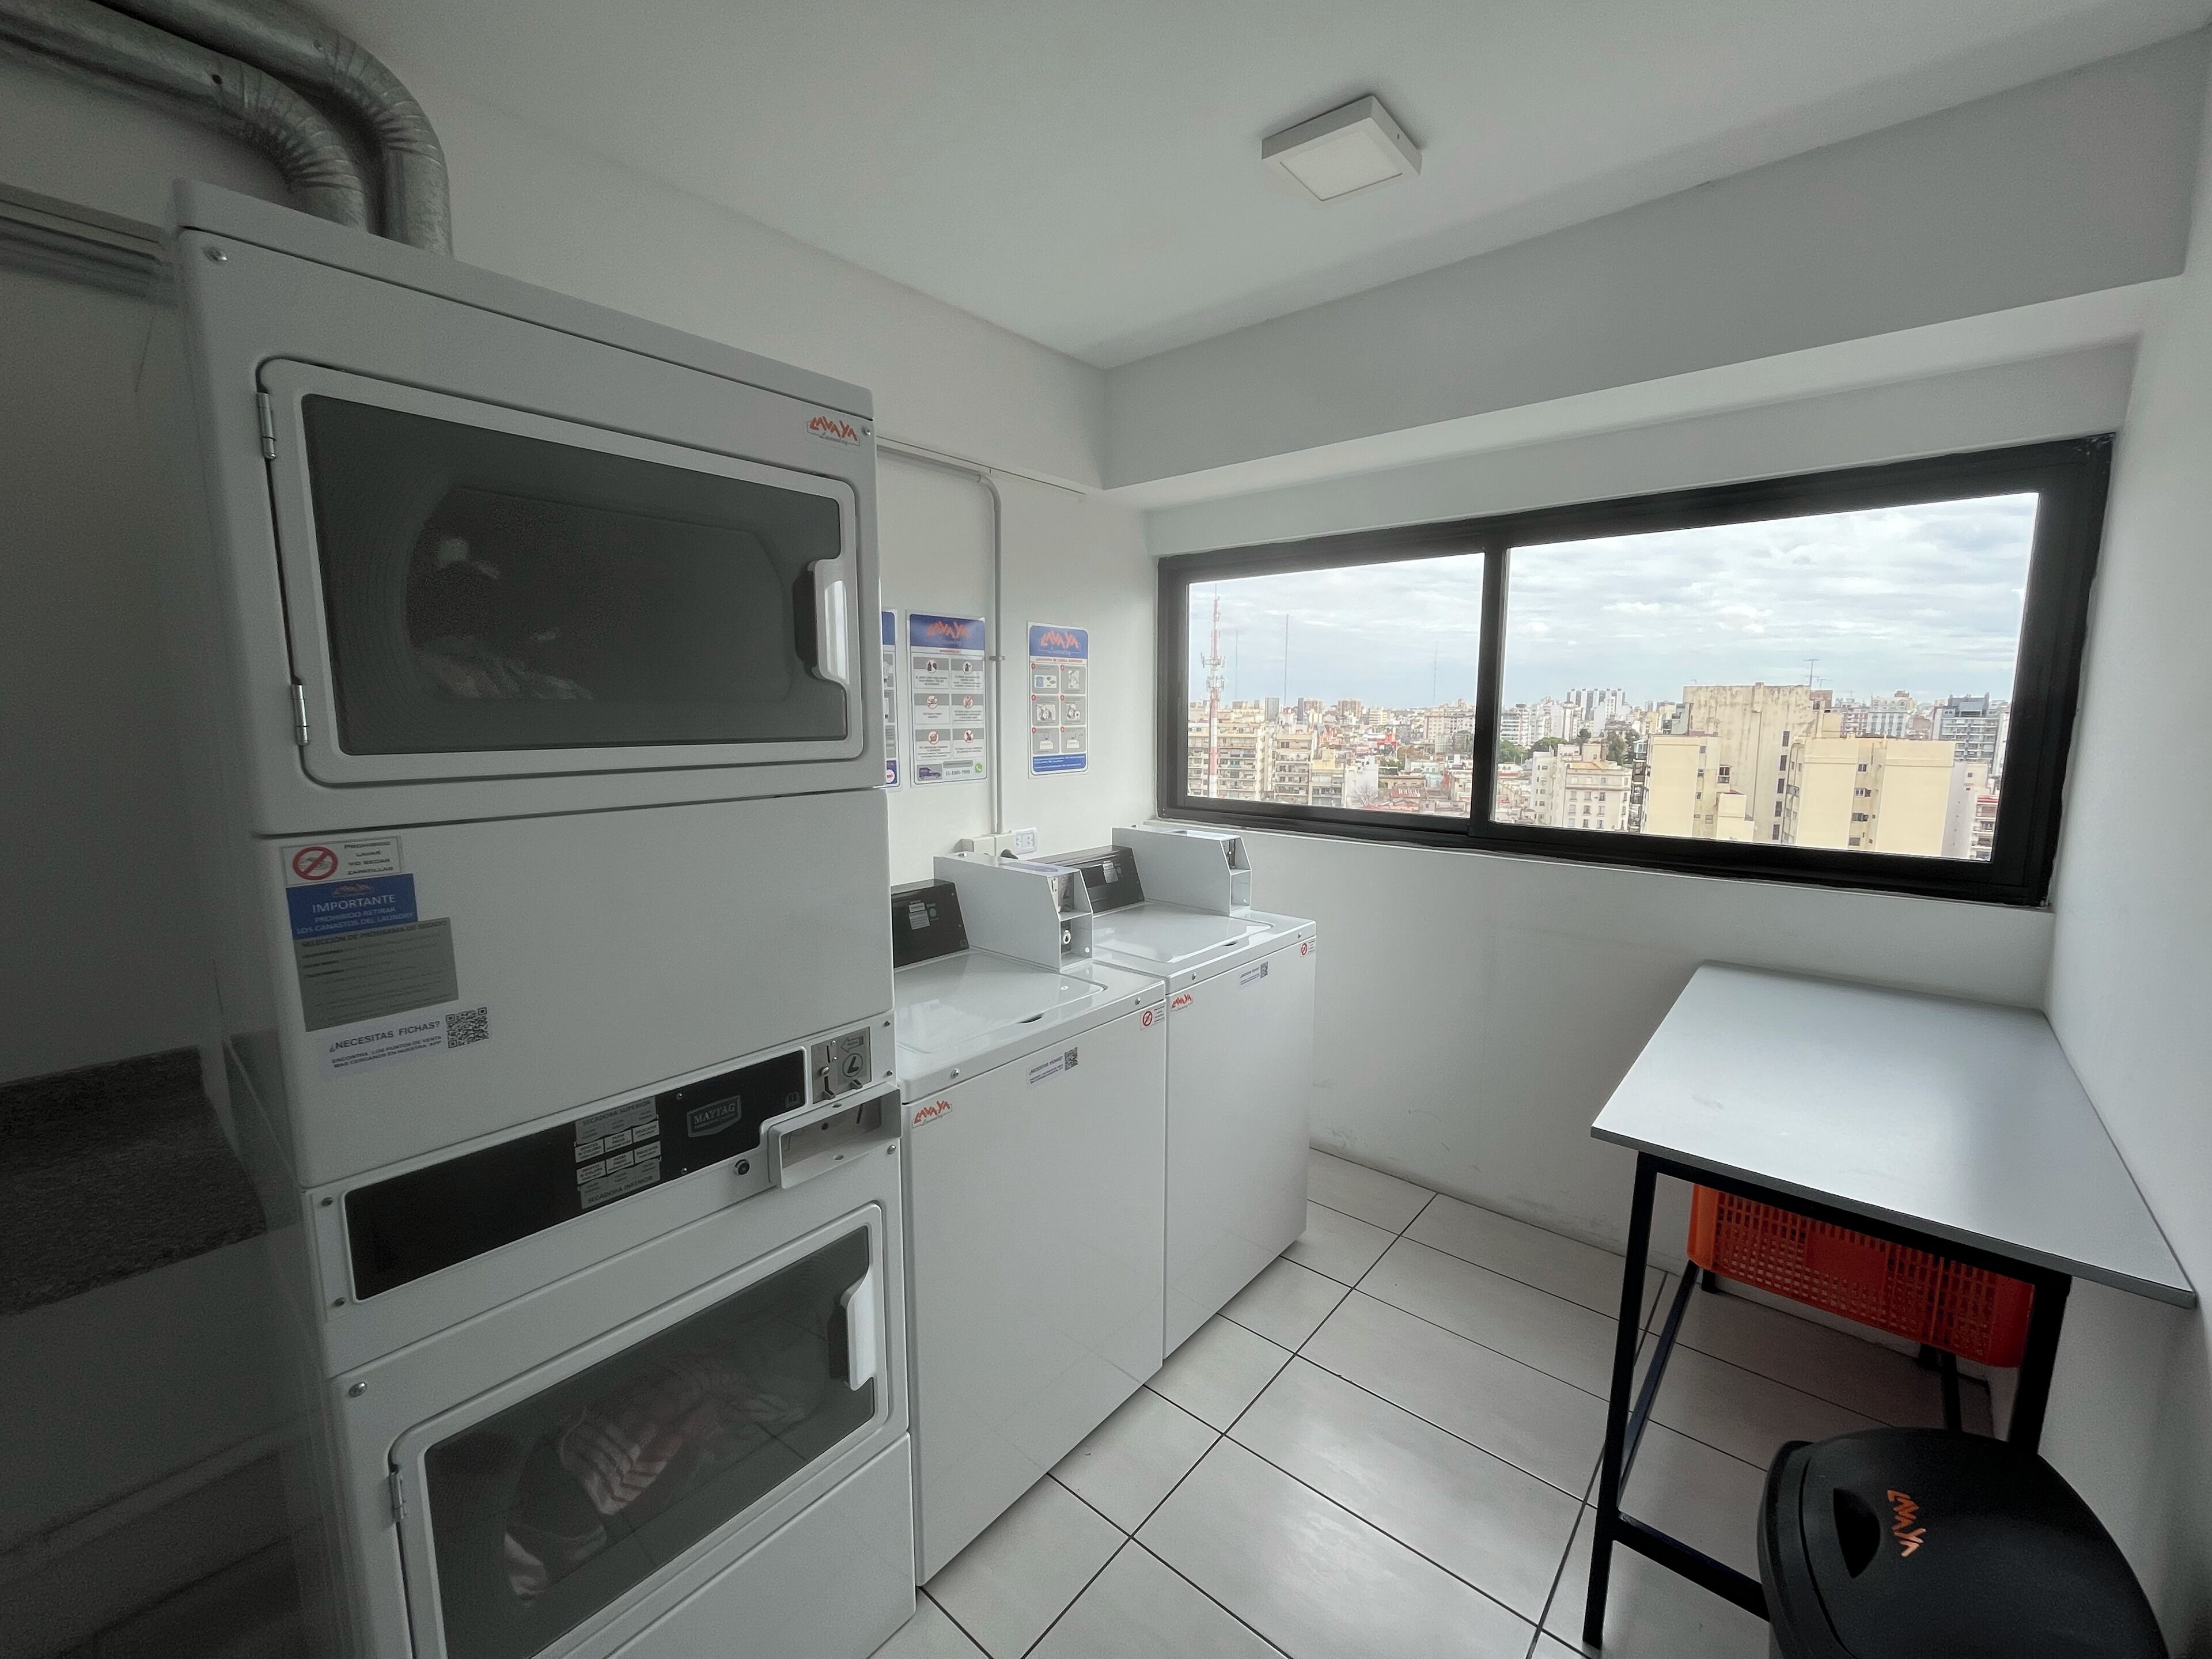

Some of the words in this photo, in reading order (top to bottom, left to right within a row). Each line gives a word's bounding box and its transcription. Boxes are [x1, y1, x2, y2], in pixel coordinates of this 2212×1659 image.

[809, 416, 858, 442] LAVAYA
[1040, 630, 1080, 650] LAVAYA
[344, 841, 391, 849] PROHIBIDO
[348, 866, 394, 875] ZAPATILLAS
[312, 894, 397, 914] IMPORTANTE
[314, 911, 362, 923] PROHIBIDO
[363, 906, 396, 916] RETIRAR
[297, 926, 314, 934] LOS
[315, 921, 359, 931] CANASTOS
[377, 912, 414, 922] LAUNDRY
[1172, 993, 1192, 1008] LAVAYA
[329, 1031, 395, 1053] ¿NECESITAS
[398, 1020, 441, 1036] FICHAS?
[582, 1109, 618, 1125] SECADORA
[618, 1100, 651, 1115] SUPERIOR
[693, 1103, 736, 1124] MAYTAG
[914, 1100, 951, 1124] LAVAYA
[588, 1187, 623, 1203] SECADORA
[624, 1175, 654, 1191] INFERIOR
[1887, 1489, 1927, 1557] LAVAYA
